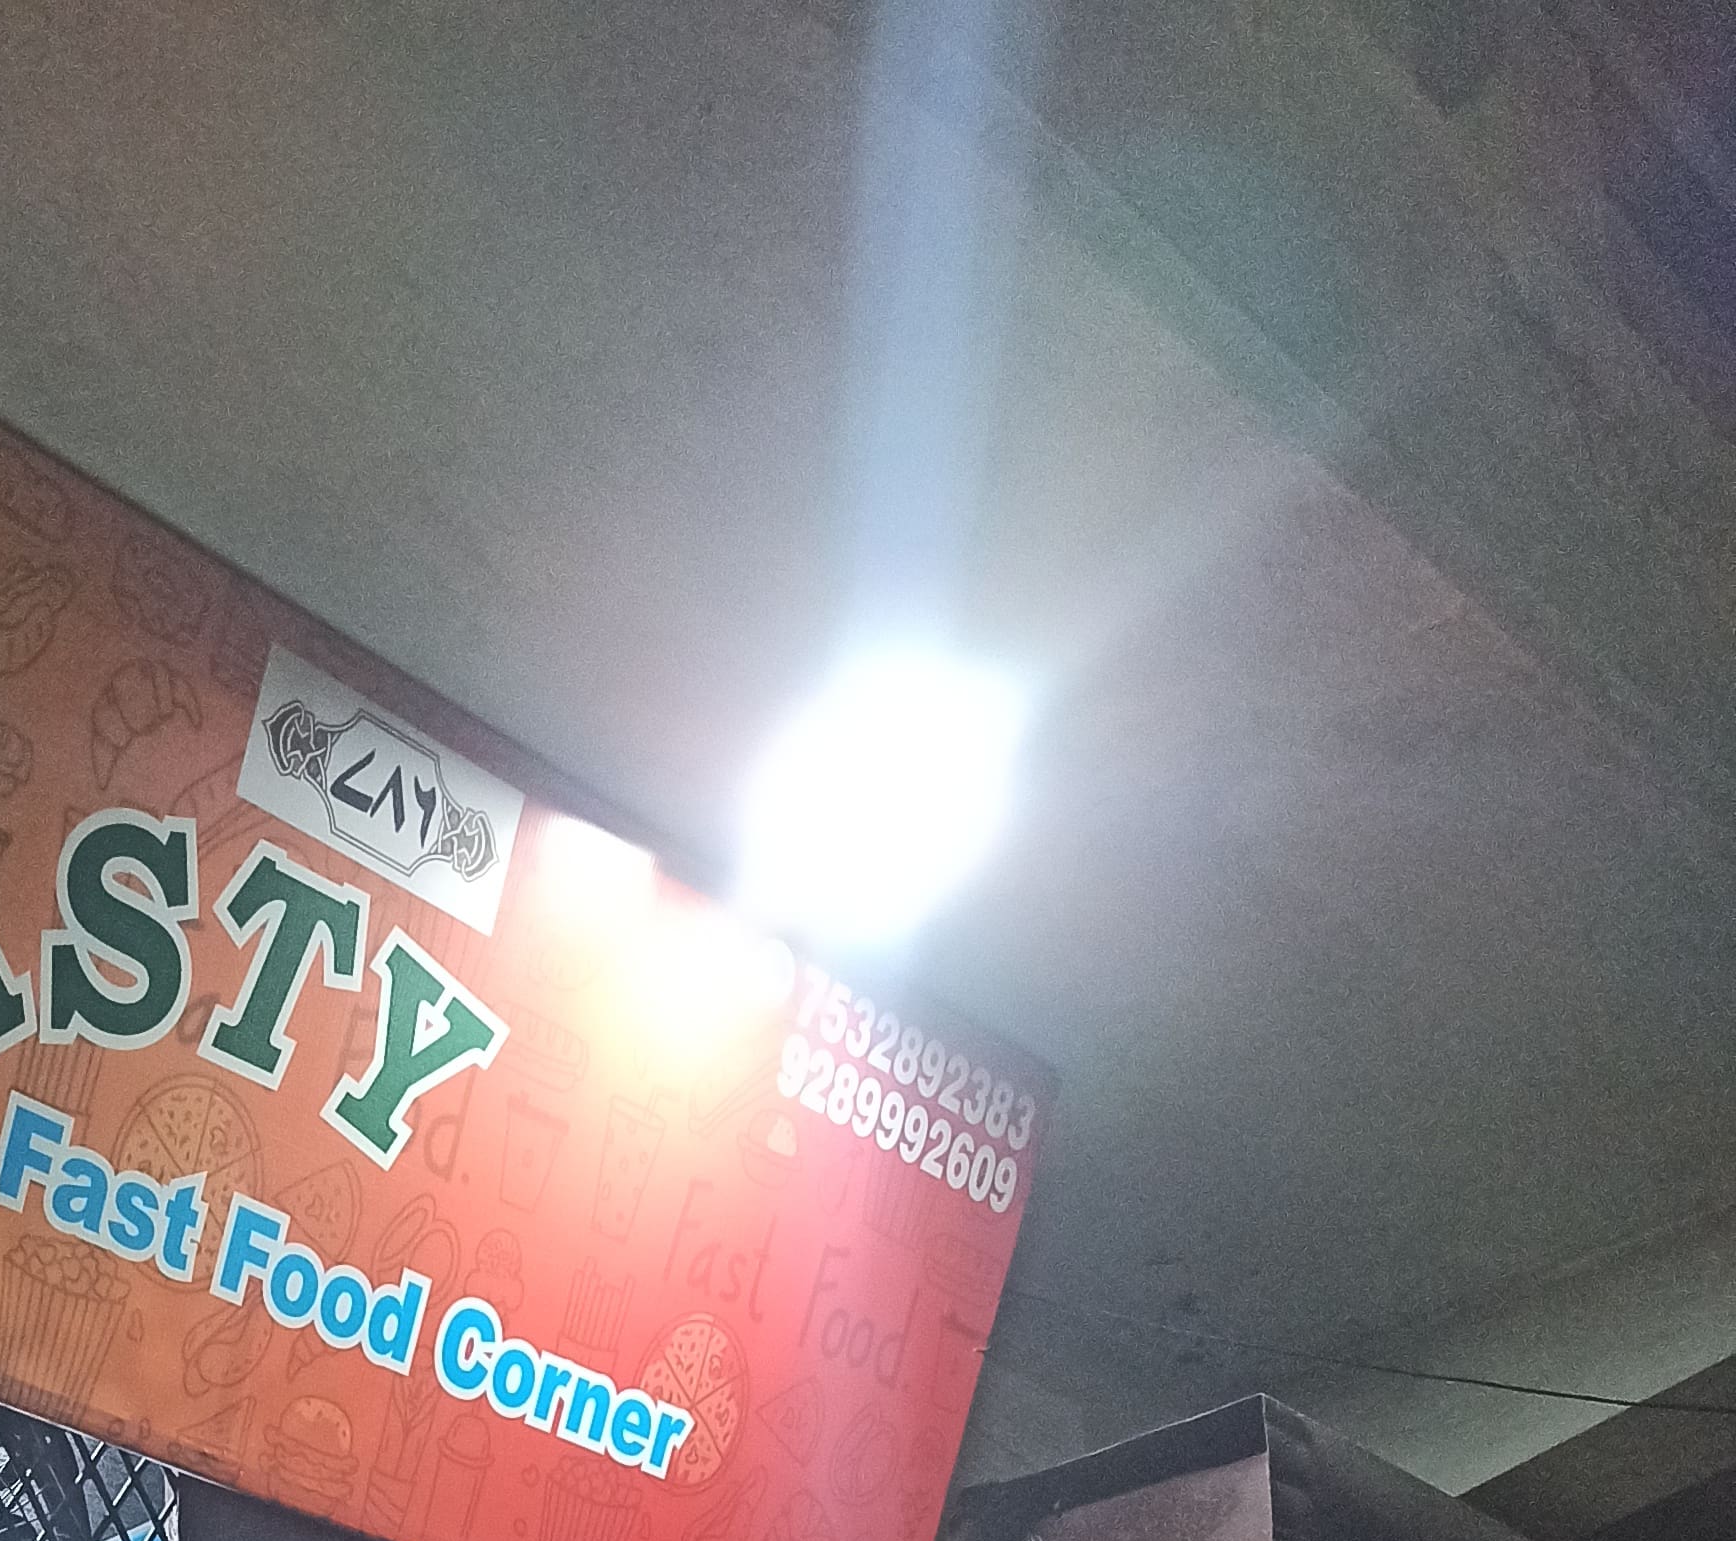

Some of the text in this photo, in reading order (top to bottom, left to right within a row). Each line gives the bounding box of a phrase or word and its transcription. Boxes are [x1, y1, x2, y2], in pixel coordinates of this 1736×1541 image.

[776, 1033, 1017, 1213] 9289992609
[796, 964, 1035, 1150] 7532892383
[210, 1195, 429, 1373] Food
[435, 1298, 691, 1478] Corner
